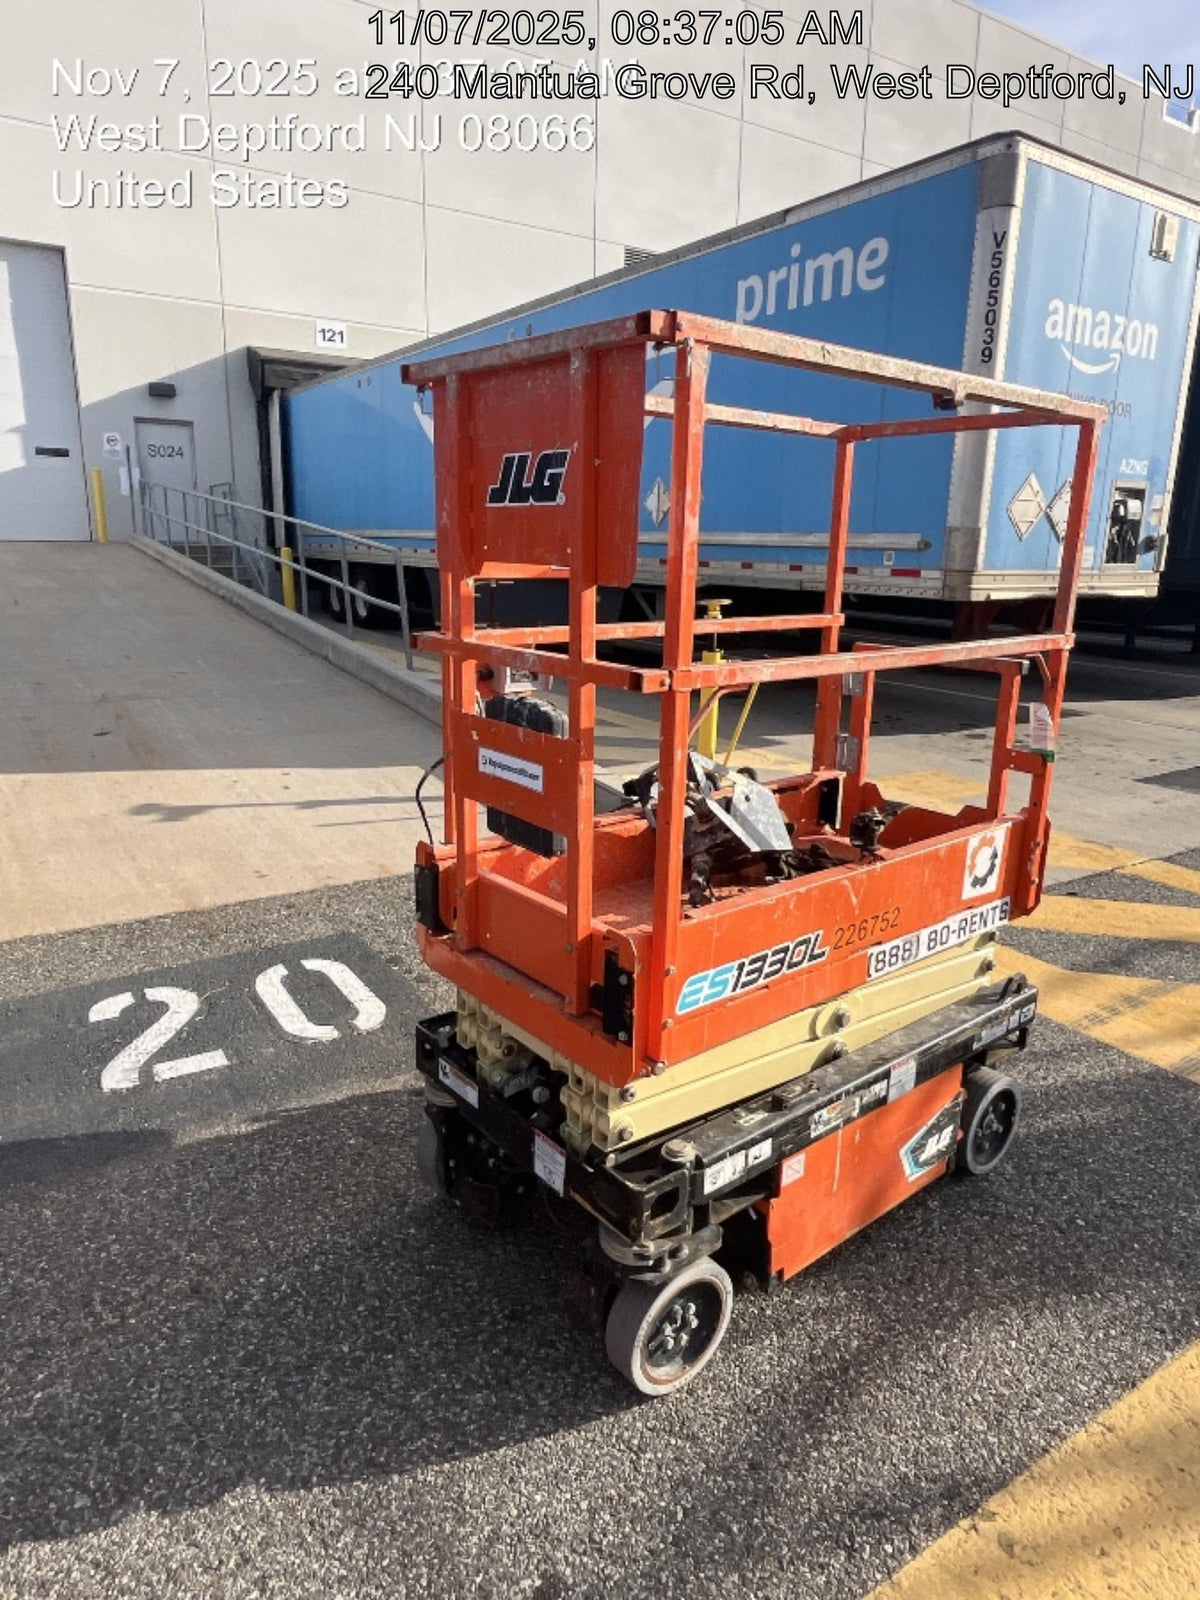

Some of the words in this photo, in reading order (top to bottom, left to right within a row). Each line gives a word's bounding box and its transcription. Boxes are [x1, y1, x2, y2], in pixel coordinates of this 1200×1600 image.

[735, 236, 889, 325] prime
[980, 230, 1007, 364] V565039
[318, 328, 344, 344] 121
[1045, 298, 1159, 360] amazon
[147, 443, 184, 459] S024
[486, 449, 570, 506] JLG
[833, 906, 901, 951] 226752
[867, 934, 920, 978] (888)
[677, 931, 829, 1013] ES1330L
[88, 958, 387, 1092] 20
